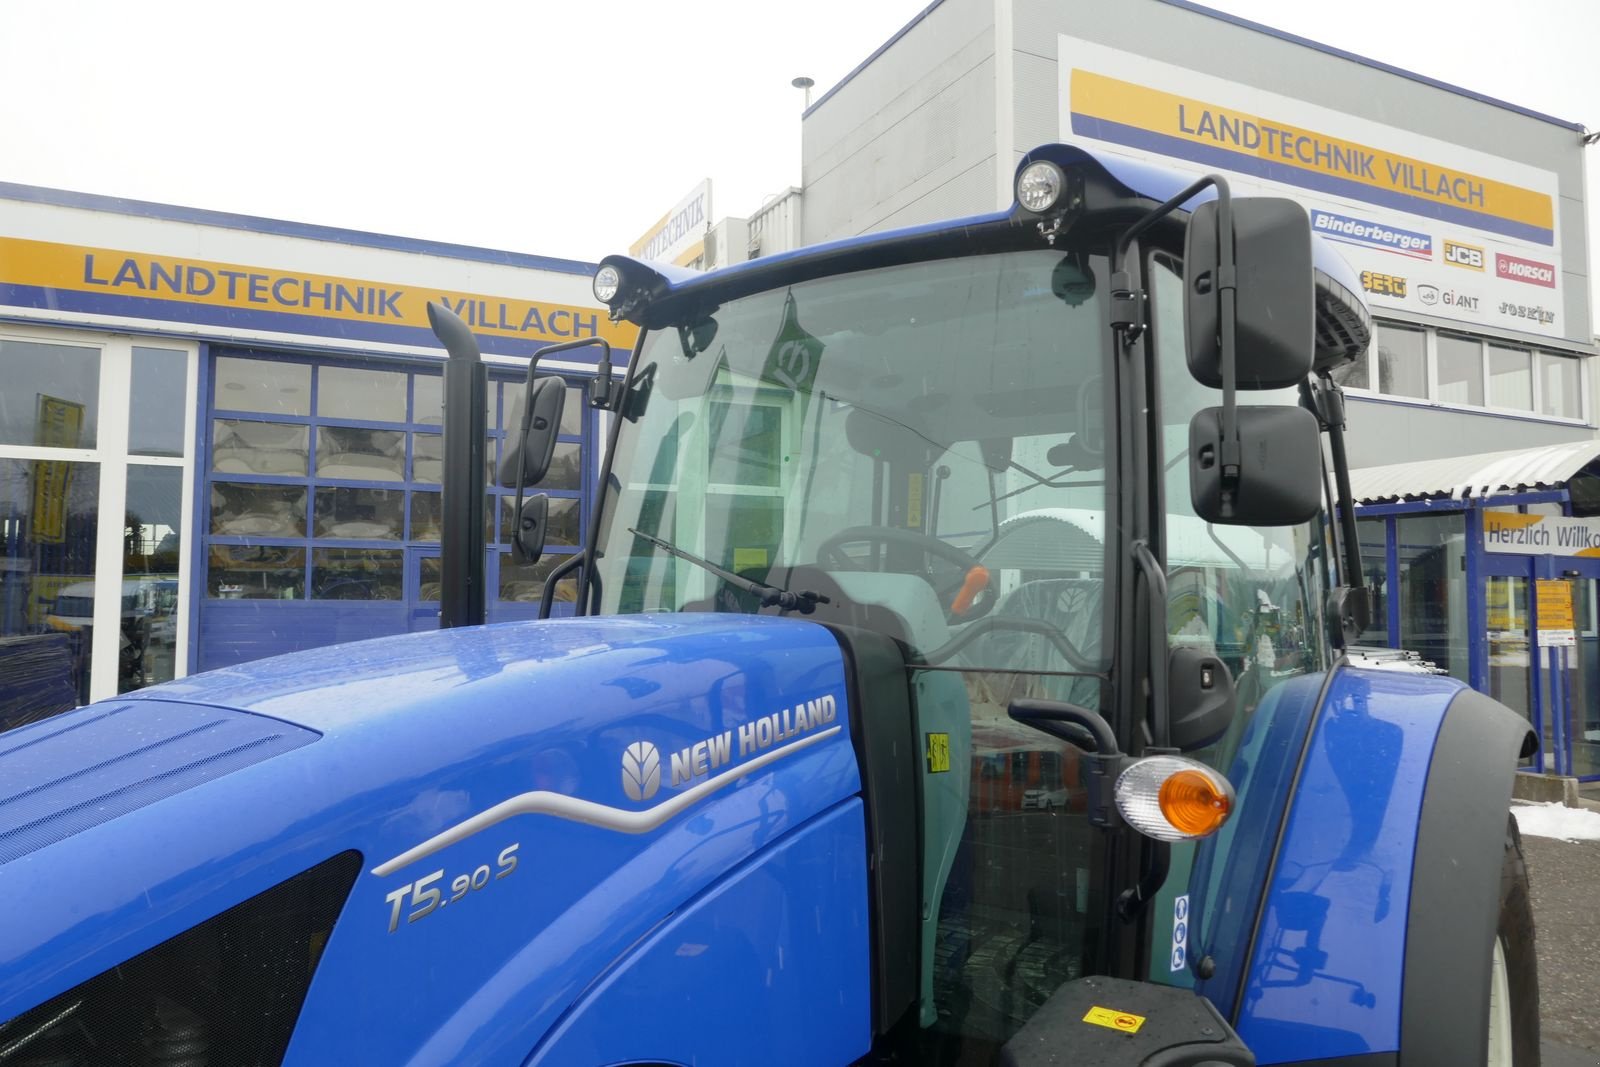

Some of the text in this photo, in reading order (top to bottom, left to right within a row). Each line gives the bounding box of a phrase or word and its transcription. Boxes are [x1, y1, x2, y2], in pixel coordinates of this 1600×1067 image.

[1178, 104, 1484, 207] LANDTECHNIK VILLACH
[1314, 214, 1430, 250] Binderberger
[1445, 247, 1482, 267] JCB
[83, 254, 404, 319] LANDTECHNIK
[1508, 261, 1553, 283] HORSCH
[1489, 521, 1550, 546] Herzlich
[671, 694, 836, 787] NEW HOLLAND
[385, 843, 519, 934] T5.90 S
